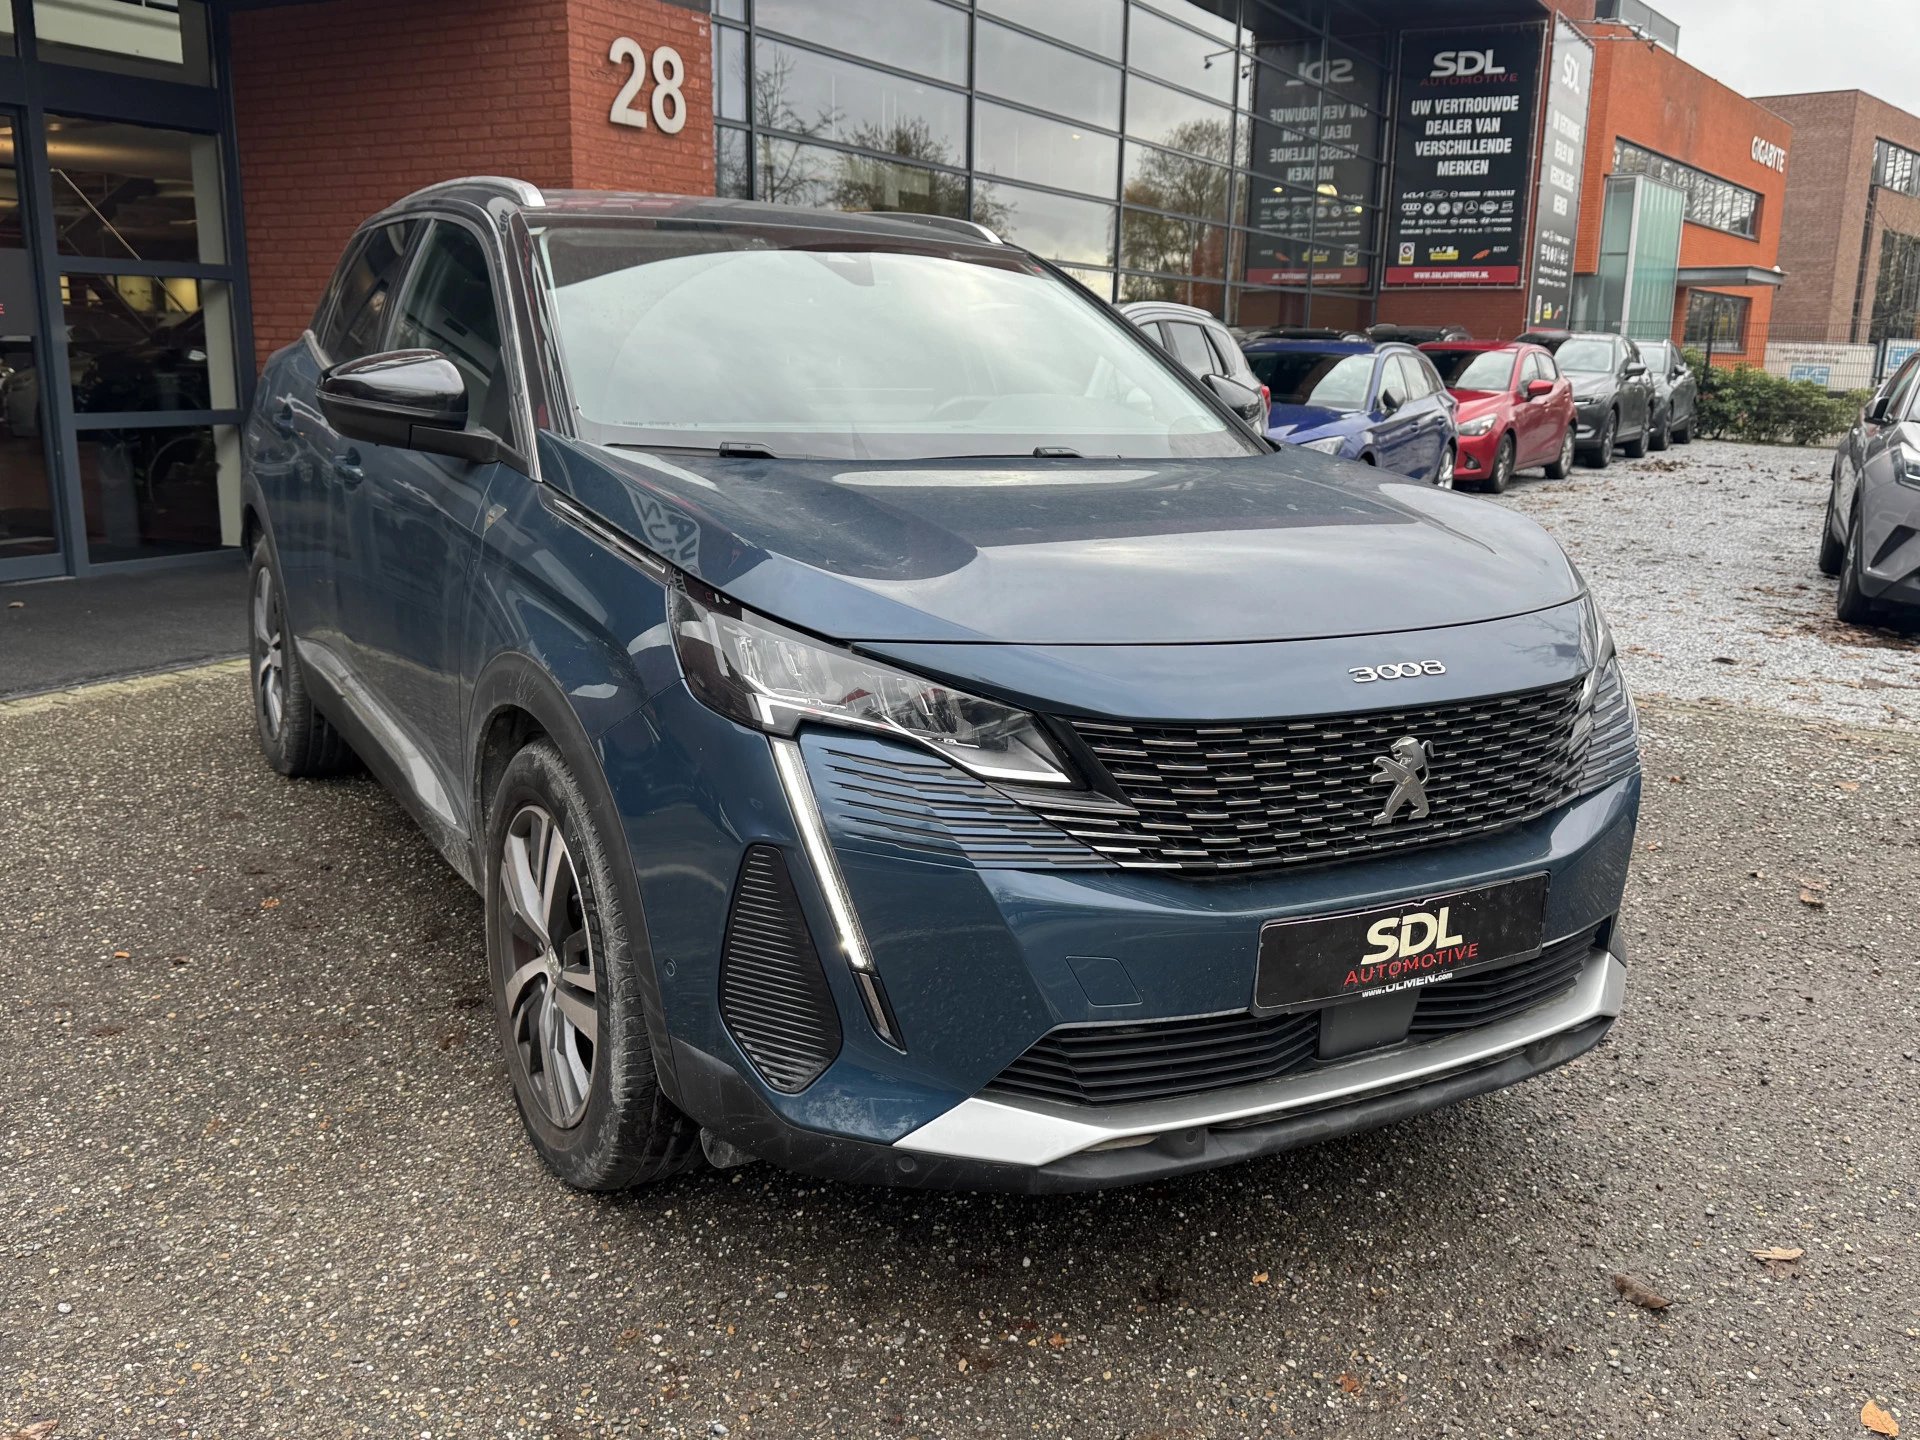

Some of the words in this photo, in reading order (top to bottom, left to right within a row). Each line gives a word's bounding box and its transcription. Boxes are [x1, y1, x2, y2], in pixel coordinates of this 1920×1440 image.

[1430, 49, 1505, 77] SDL
[1561, 52, 1580, 94] SDL
[609, 36, 687, 134] 28
[1420, 73, 1518, 87] AUTOMOTIVE
[1411, 100, 1432, 115] UW
[1435, 95, 1520, 115] VERTROUWDE
[1425, 118, 1472, 136] DEALER
[1475, 117, 1501, 134] VAN
[1415, 138, 1512, 157] VERSCHILLENDE
[1751, 135, 1785, 174] GIGABYTE
[1437, 159, 1490, 176] MERKEN
[1348, 659, 1447, 683] 3008
[1360, 906, 1463, 965] SDL
[1343, 942, 1480, 987] AUTOMOTIVE
